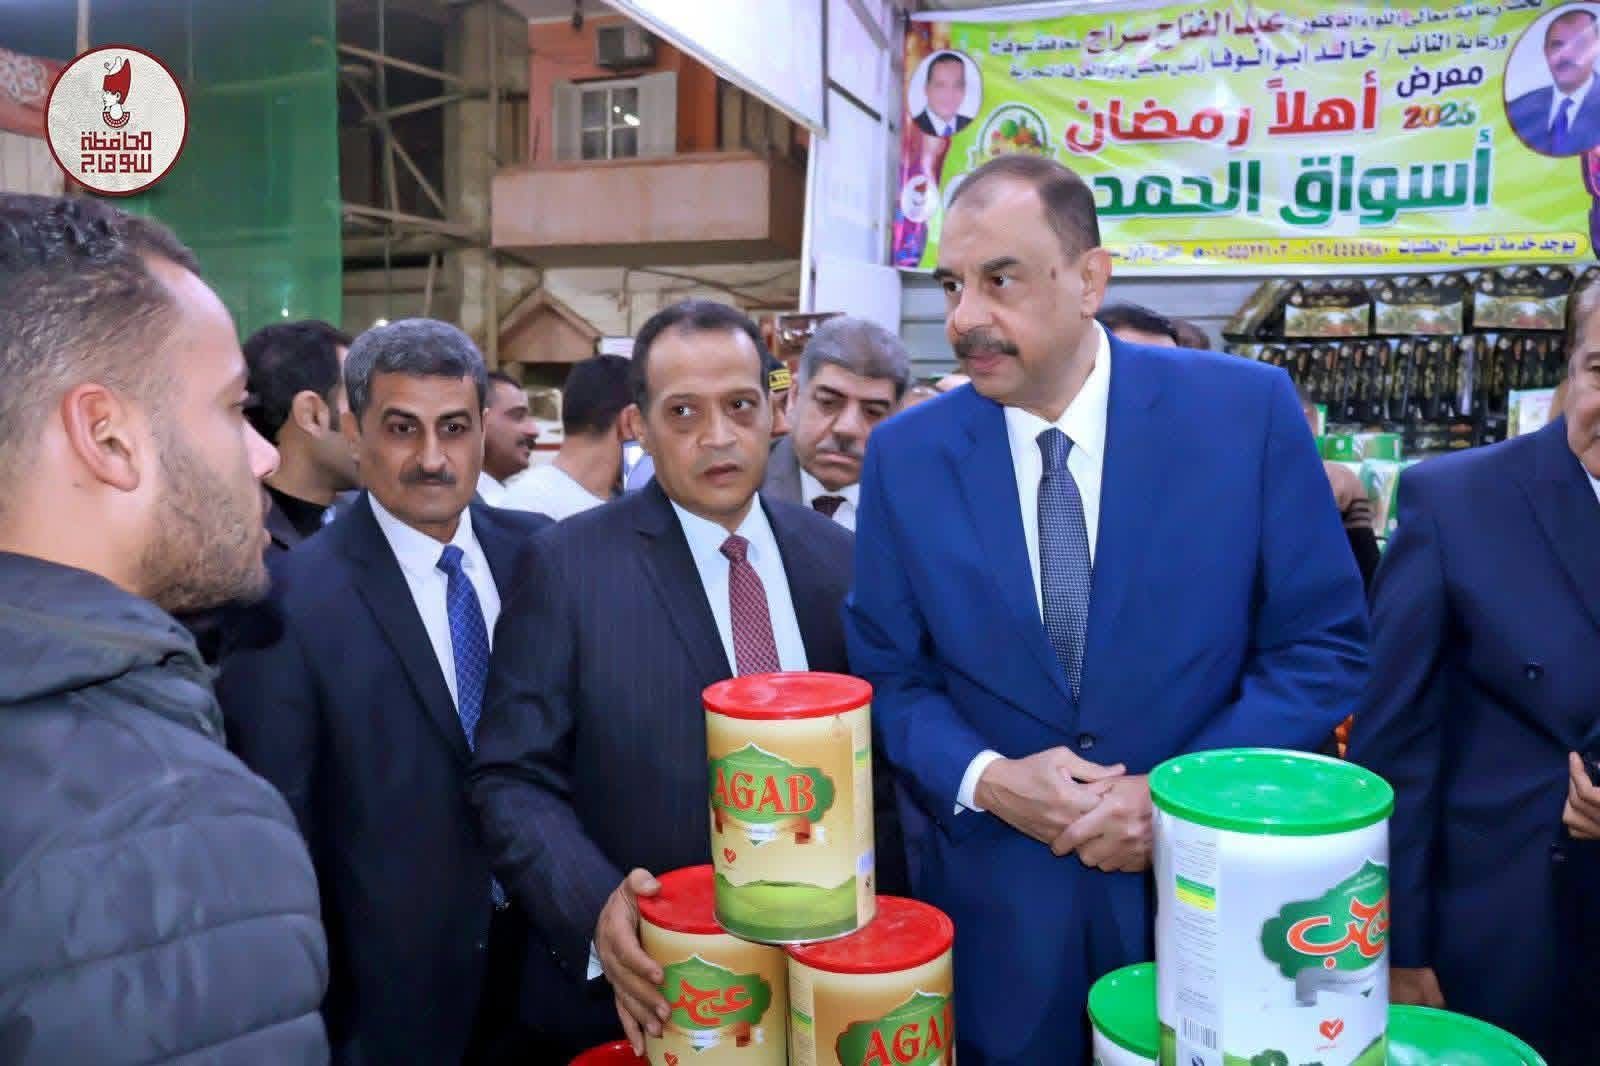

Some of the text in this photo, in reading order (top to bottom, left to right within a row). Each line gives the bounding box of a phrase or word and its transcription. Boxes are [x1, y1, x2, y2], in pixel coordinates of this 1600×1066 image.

[1455, 4, 1502, 20] رعاية
[1087, 23, 1149, 54] سراج
[1314, 37, 1376, 61] خالد
[1397, 34, 1451, 60] النائب
[1455, 34, 1508, 53] ورعاية
[1397, 65, 1483, 98] معرض
[1065, 70, 1379, 152] أهلاً رمضان
[1279, 129, 1492, 225] أسواق
[1500, 236, 1537, 251] خدمة
[1539, 237, 1576, 255] يوجد
[715, 766, 818, 815] AGAB
